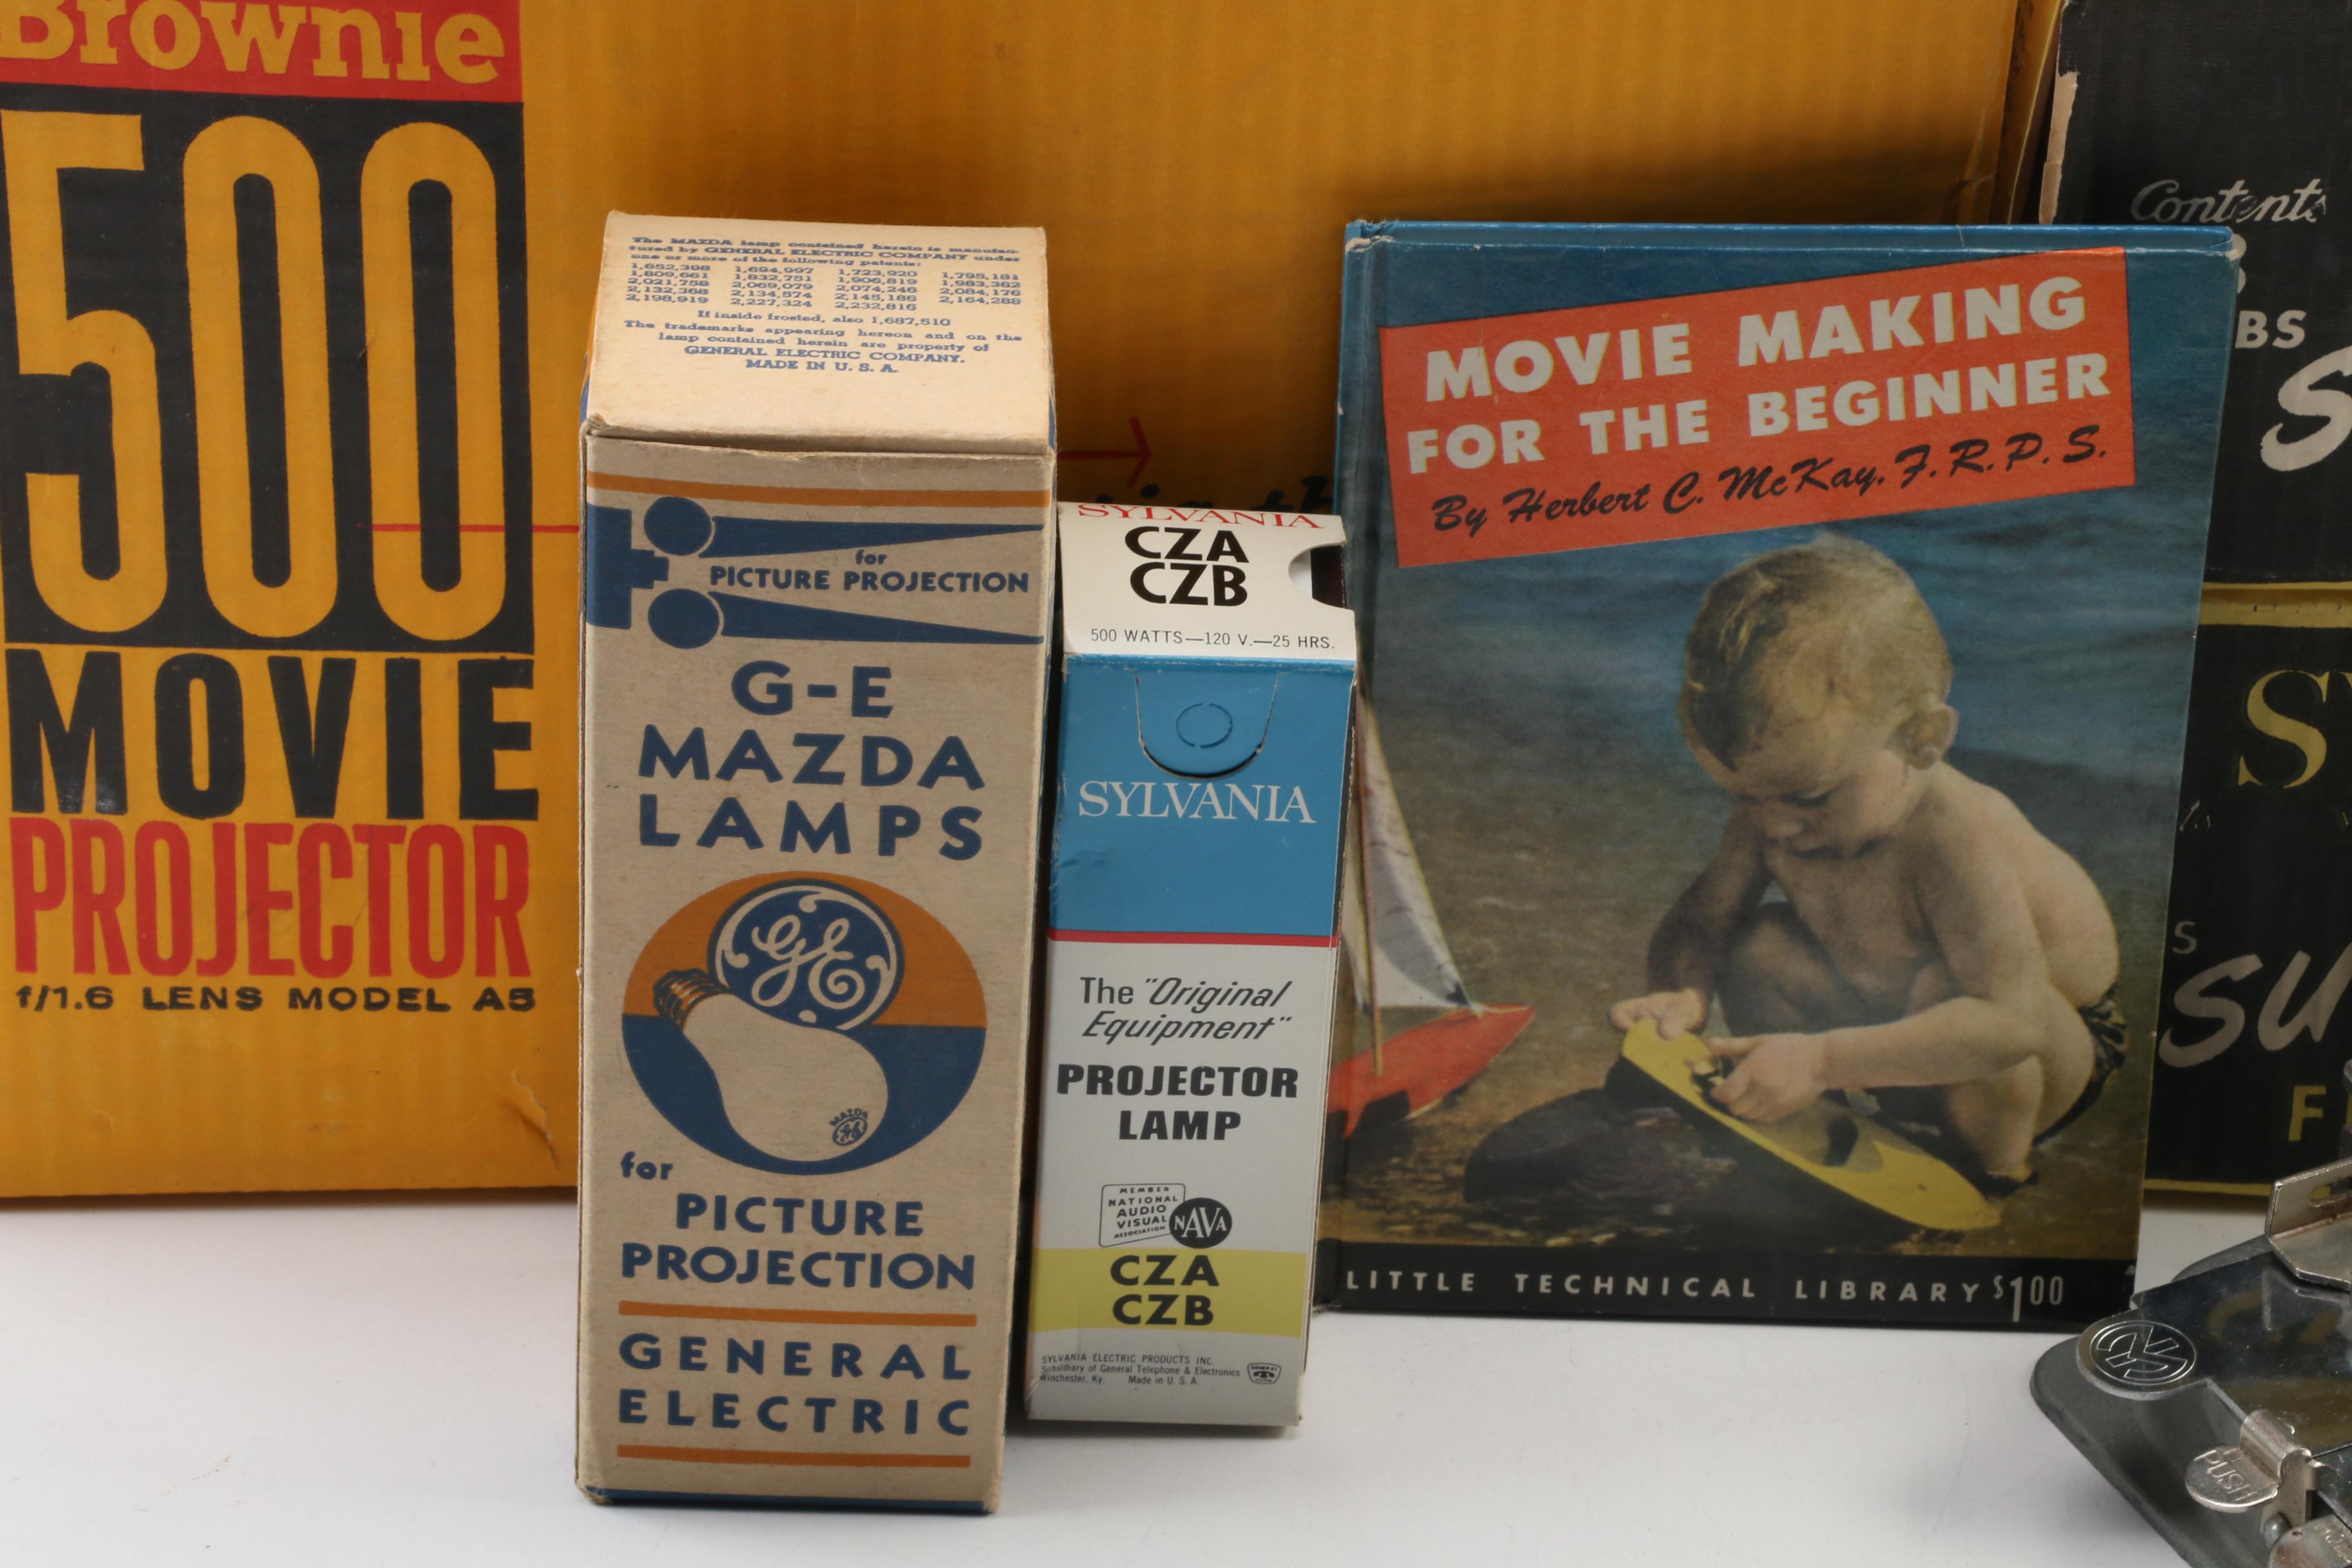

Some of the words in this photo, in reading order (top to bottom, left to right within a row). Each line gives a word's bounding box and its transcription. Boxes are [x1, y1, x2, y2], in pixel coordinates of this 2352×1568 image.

[0, 0, 505, 84] Brownie
[704, 247, 785, 255] GENERAL
[790, 249, 874, 257] ELECTRIC
[878, 251, 968, 260] COMPANY
[782, 257, 854, 266] following
[624, 320, 655, 328] The
[665, 322, 754, 333] trademarks
[765, 328, 845, 337] appearing
[858, 329, 913, 338] hereon
[768, 313, 825, 322] frosted,
[658, 332, 699, 342] lamp
[707, 335, 785, 344] contained
[798, 337, 848, 347] herein
[897, 343, 965, 352] property
[685, 345, 767, 356] GENERAL
[776, 348, 861, 359] ELECTRIC
[869, 351, 965, 363] COMPANY.
[1426, 322, 1692, 402] MOVIE
[1738, 277, 2086, 367] MAKING
[1, 110, 506, 641] 500
[746, 359, 799, 369] MADE
[807, 361, 826, 370] IN
[834, 362, 852, 371] U.
[858, 362, 874, 372] S.
[881, 364, 899, 373] A.
[1407, 418, 1545, 475] FOR
[1580, 399, 1710, 455] THE
[1747, 353, 2112, 437] BEGINNER
[1078, 503, 1326, 529] SYLVANIA
[1430, 495, 1489, 538] By
[1502, 481, 1651, 523] Herbert
[1663, 471, 1703, 514] C.
[855, 549, 887, 566] for
[1124, 526, 1250, 563] CZA
[709, 565, 830, 590] PICTURE
[843, 570, 1030, 593] PROJECTION
[1130, 562, 1248, 607] CZB
[1091, 628, 1117, 642] 500
[1298, 636, 1335, 649] HRS.
[731, 660, 894, 719] G-E
[5, 648, 539, 821] MOVIE
[2238, 669, 2352, 789] S
[638, 723, 986, 790] MAZDA
[1079, 780, 1317, 823] SYLVANIA
[640, 793, 983, 861] LAMPS
[8, 816, 532, 979] PROJECTOR
[15, 986, 114, 1012] f/1.6
[142, 986, 264, 1012] LENS
[288, 987, 452, 1012] MODEL
[1080, 977, 1134, 1004] The
[1056, 1064, 1298, 1098] PROJECTOR
[1119, 1110, 1241, 1141] LAMP
[620, 1151, 674, 1180] for
[676, 1192, 924, 1237] PICTURE
[1108, 1195, 1178, 1206] NATIONAL
[1117, 1204, 1166, 1218] AUDIO
[1113, 1226, 1166, 1239] ASSOCIATION
[1117, 1215, 1167, 1230] VISUAL
[1173, 1206, 1228, 1238] NAVA
[622, 1242, 975, 1289] PROJECTION
[1110, 1255, 1220, 1287] CZA
[1347, 1271, 1475, 1291] LITTLE
[1515, 1273, 1755, 1298] TECHNICAL
[1795, 1280, 1979, 1302] LIBRARY
[1112, 1294, 1215, 1326] CZB
[619, 1333, 972, 1380] GENERAL
[1041, 1363, 1084, 1373] Subsidiary
[1100, 1364, 1133, 1373] General
[1137, 1365, 1180, 1375] Telephone
[1184, 1366, 1191, 1375] &
[1195, 1366, 1240, 1377] Electronics
[1042, 1353, 1087, 1364] SYLVANIA
[1093, 1353, 1136, 1363] ELECTRIC
[1142, 1355, 1190, 1364] PRODUCTS
[1128, 1376, 1151, 1384] Made
[618, 1388, 971, 1436] ELECTRIC
[2193, 1449, 2258, 1502] PUSH
